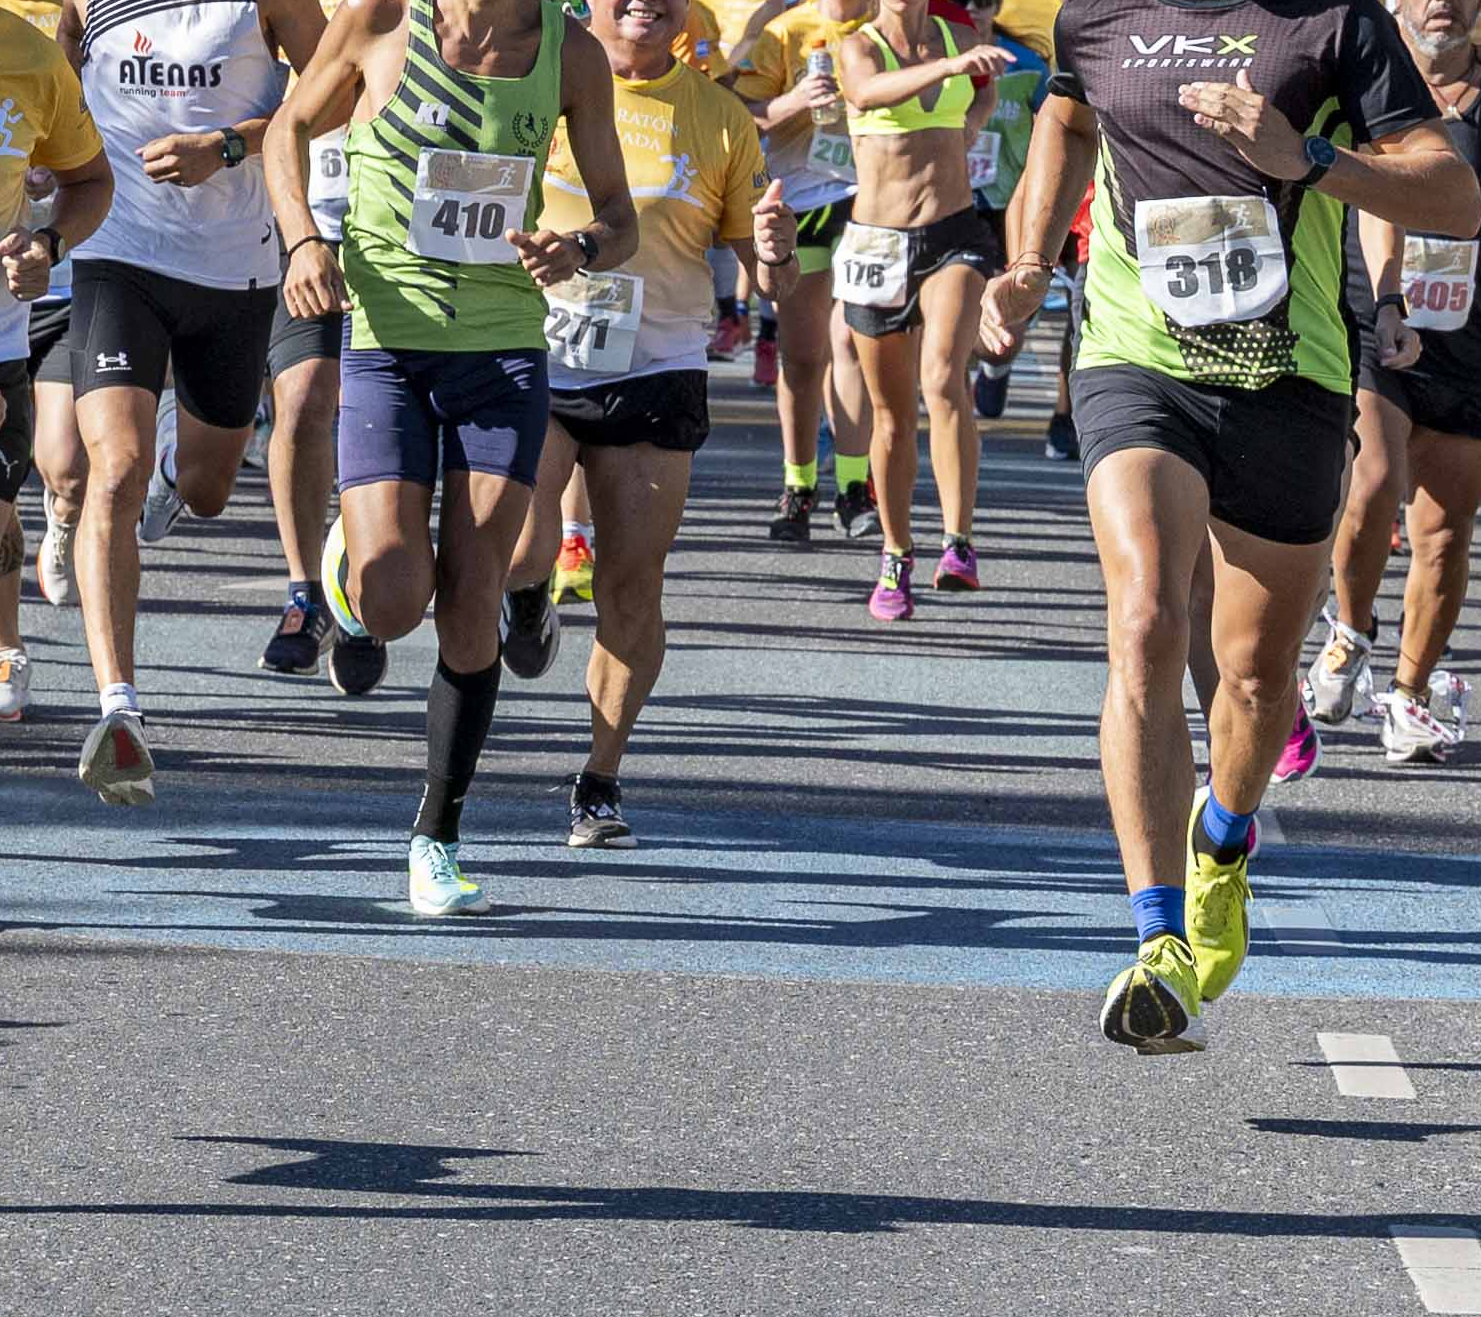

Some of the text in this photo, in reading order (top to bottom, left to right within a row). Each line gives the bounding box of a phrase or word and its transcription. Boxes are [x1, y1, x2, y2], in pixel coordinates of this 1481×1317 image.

[1129, 34, 1259, 55] VKX
[119, 55, 222, 88] ATENAS
[1122, 58, 1253, 69] SPORTSWEAR
[119, 87, 190, 98] running team
[432, 199, 506, 240] 410
[1165, 247, 1258, 299] 318
[1407, 278, 1469, 312] 405
